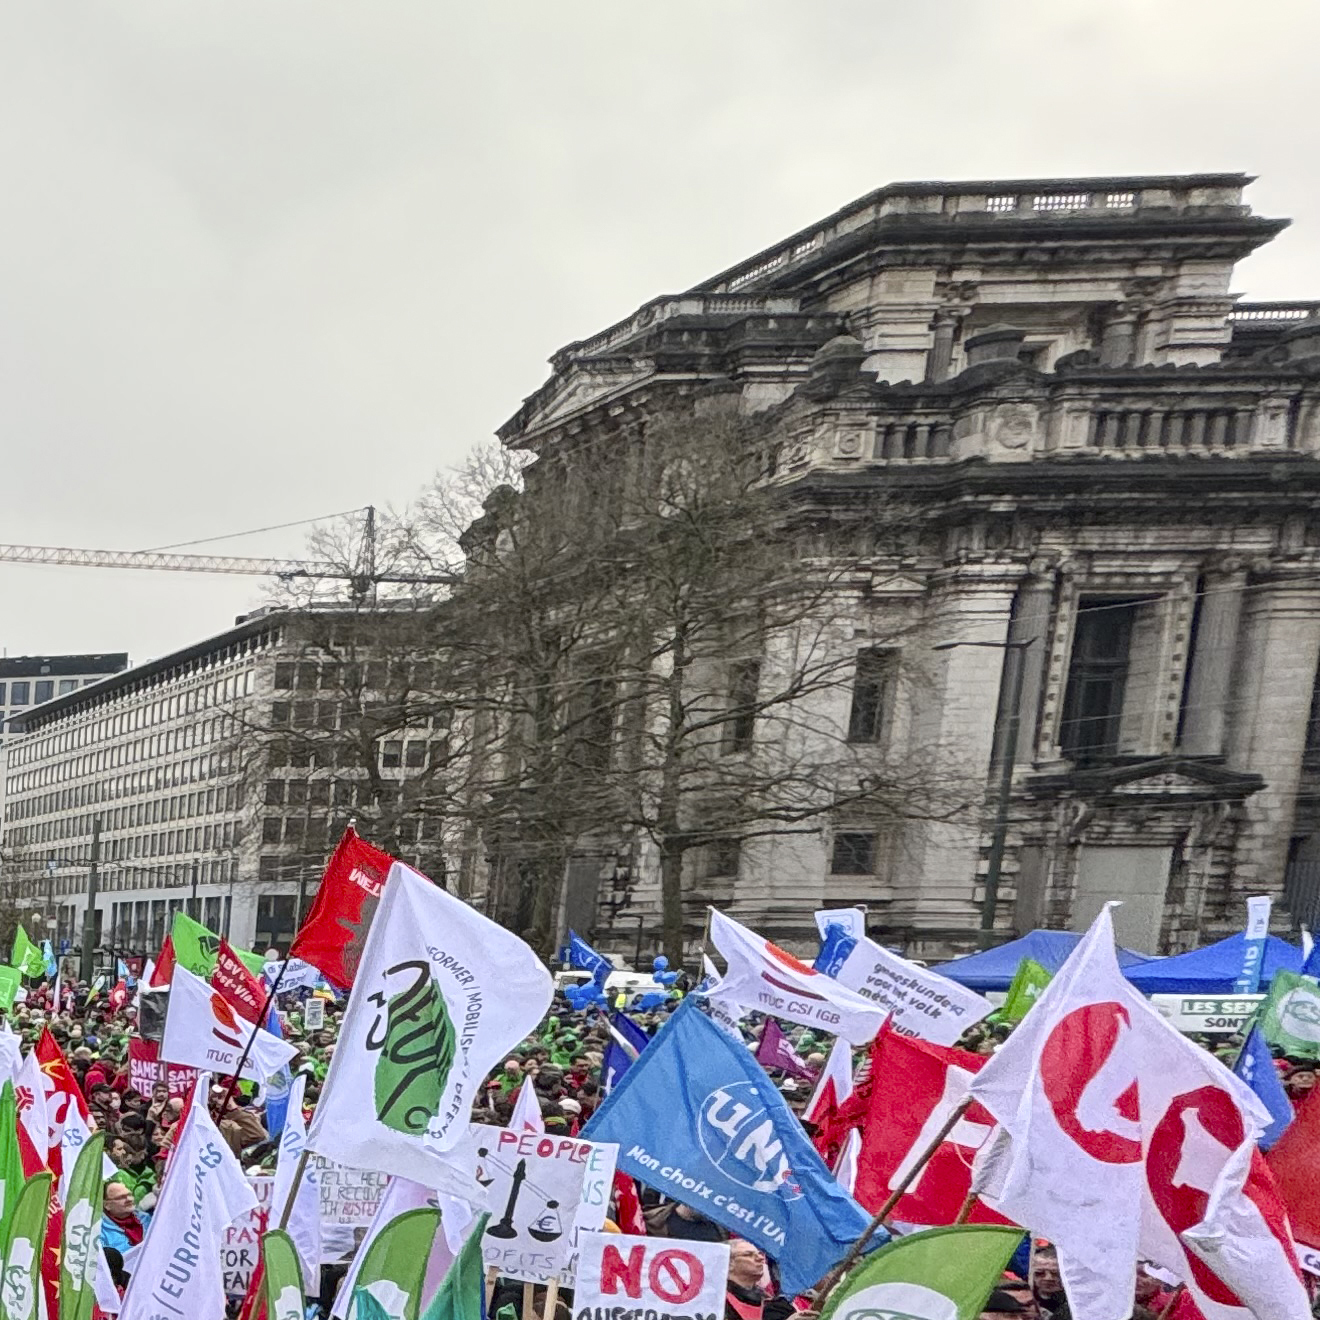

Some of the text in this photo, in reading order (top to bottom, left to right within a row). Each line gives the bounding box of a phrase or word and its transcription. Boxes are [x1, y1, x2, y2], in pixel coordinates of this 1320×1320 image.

[787, 1000, 812, 1016] CSI
[816, 1008, 841, 1025] IGB
[1182, 1001, 1217, 1013] LES
[497, 1131, 593, 1164] PEOPLE
[626, 1145, 661, 1168] Mon
[660, 1163, 715, 1200] choix
[712, 1193, 755, 1224] c'est
[600, 1244, 705, 1304] NO
